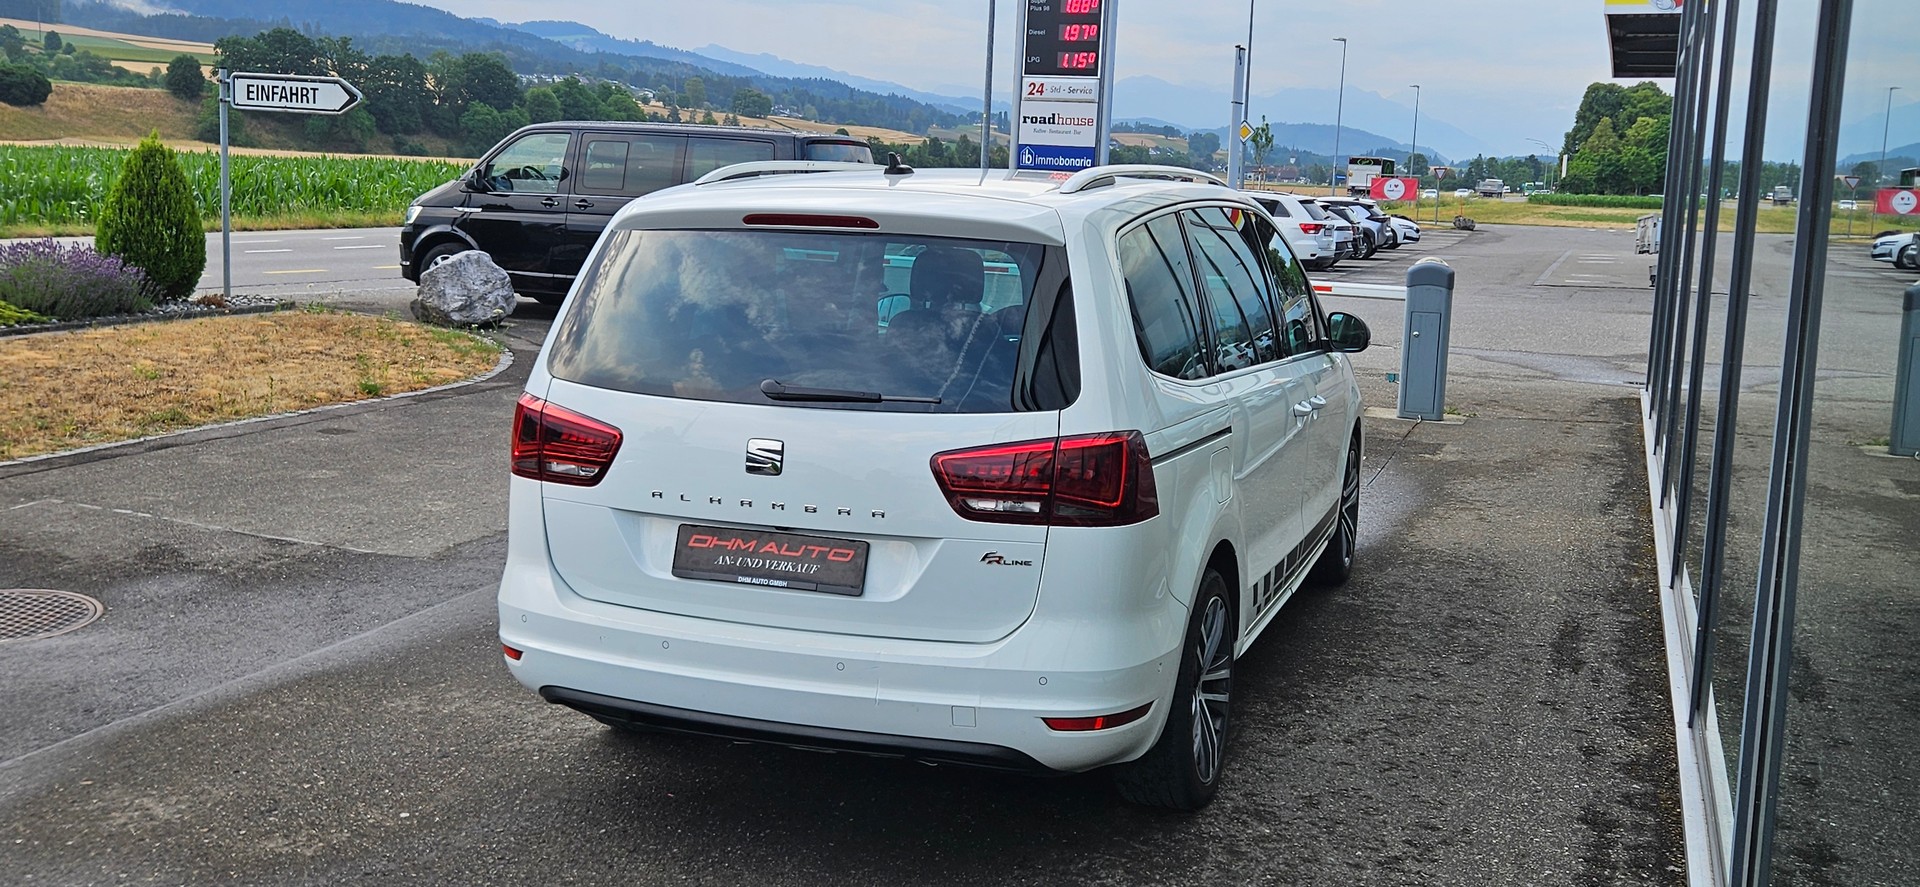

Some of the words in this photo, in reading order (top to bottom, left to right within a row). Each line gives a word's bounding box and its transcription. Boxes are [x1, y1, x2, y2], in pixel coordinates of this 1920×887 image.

[246, 83, 319, 104] EINFAHRT
[1027, 82, 1045, 96] 24
[1050, 85, 1061, 93] Std
[1068, 86, 1093, 95] Service
[1022, 112, 1094, 126] roadhouse
[1022, 149, 1033, 165] ib
[1035, 154, 1092, 167] immobonaria
[651, 489, 885, 519] ALHAMBRA
[688, 534, 757, 553] DHM
[759, 541, 855, 562] AUTO
[714, 555, 735, 565] AN-
[736, 557, 763, 568] UND
[766, 560, 821, 574] VERKAUF
[752, 577, 768, 585] AUTO
[769, 579, 788, 587] GMBH
